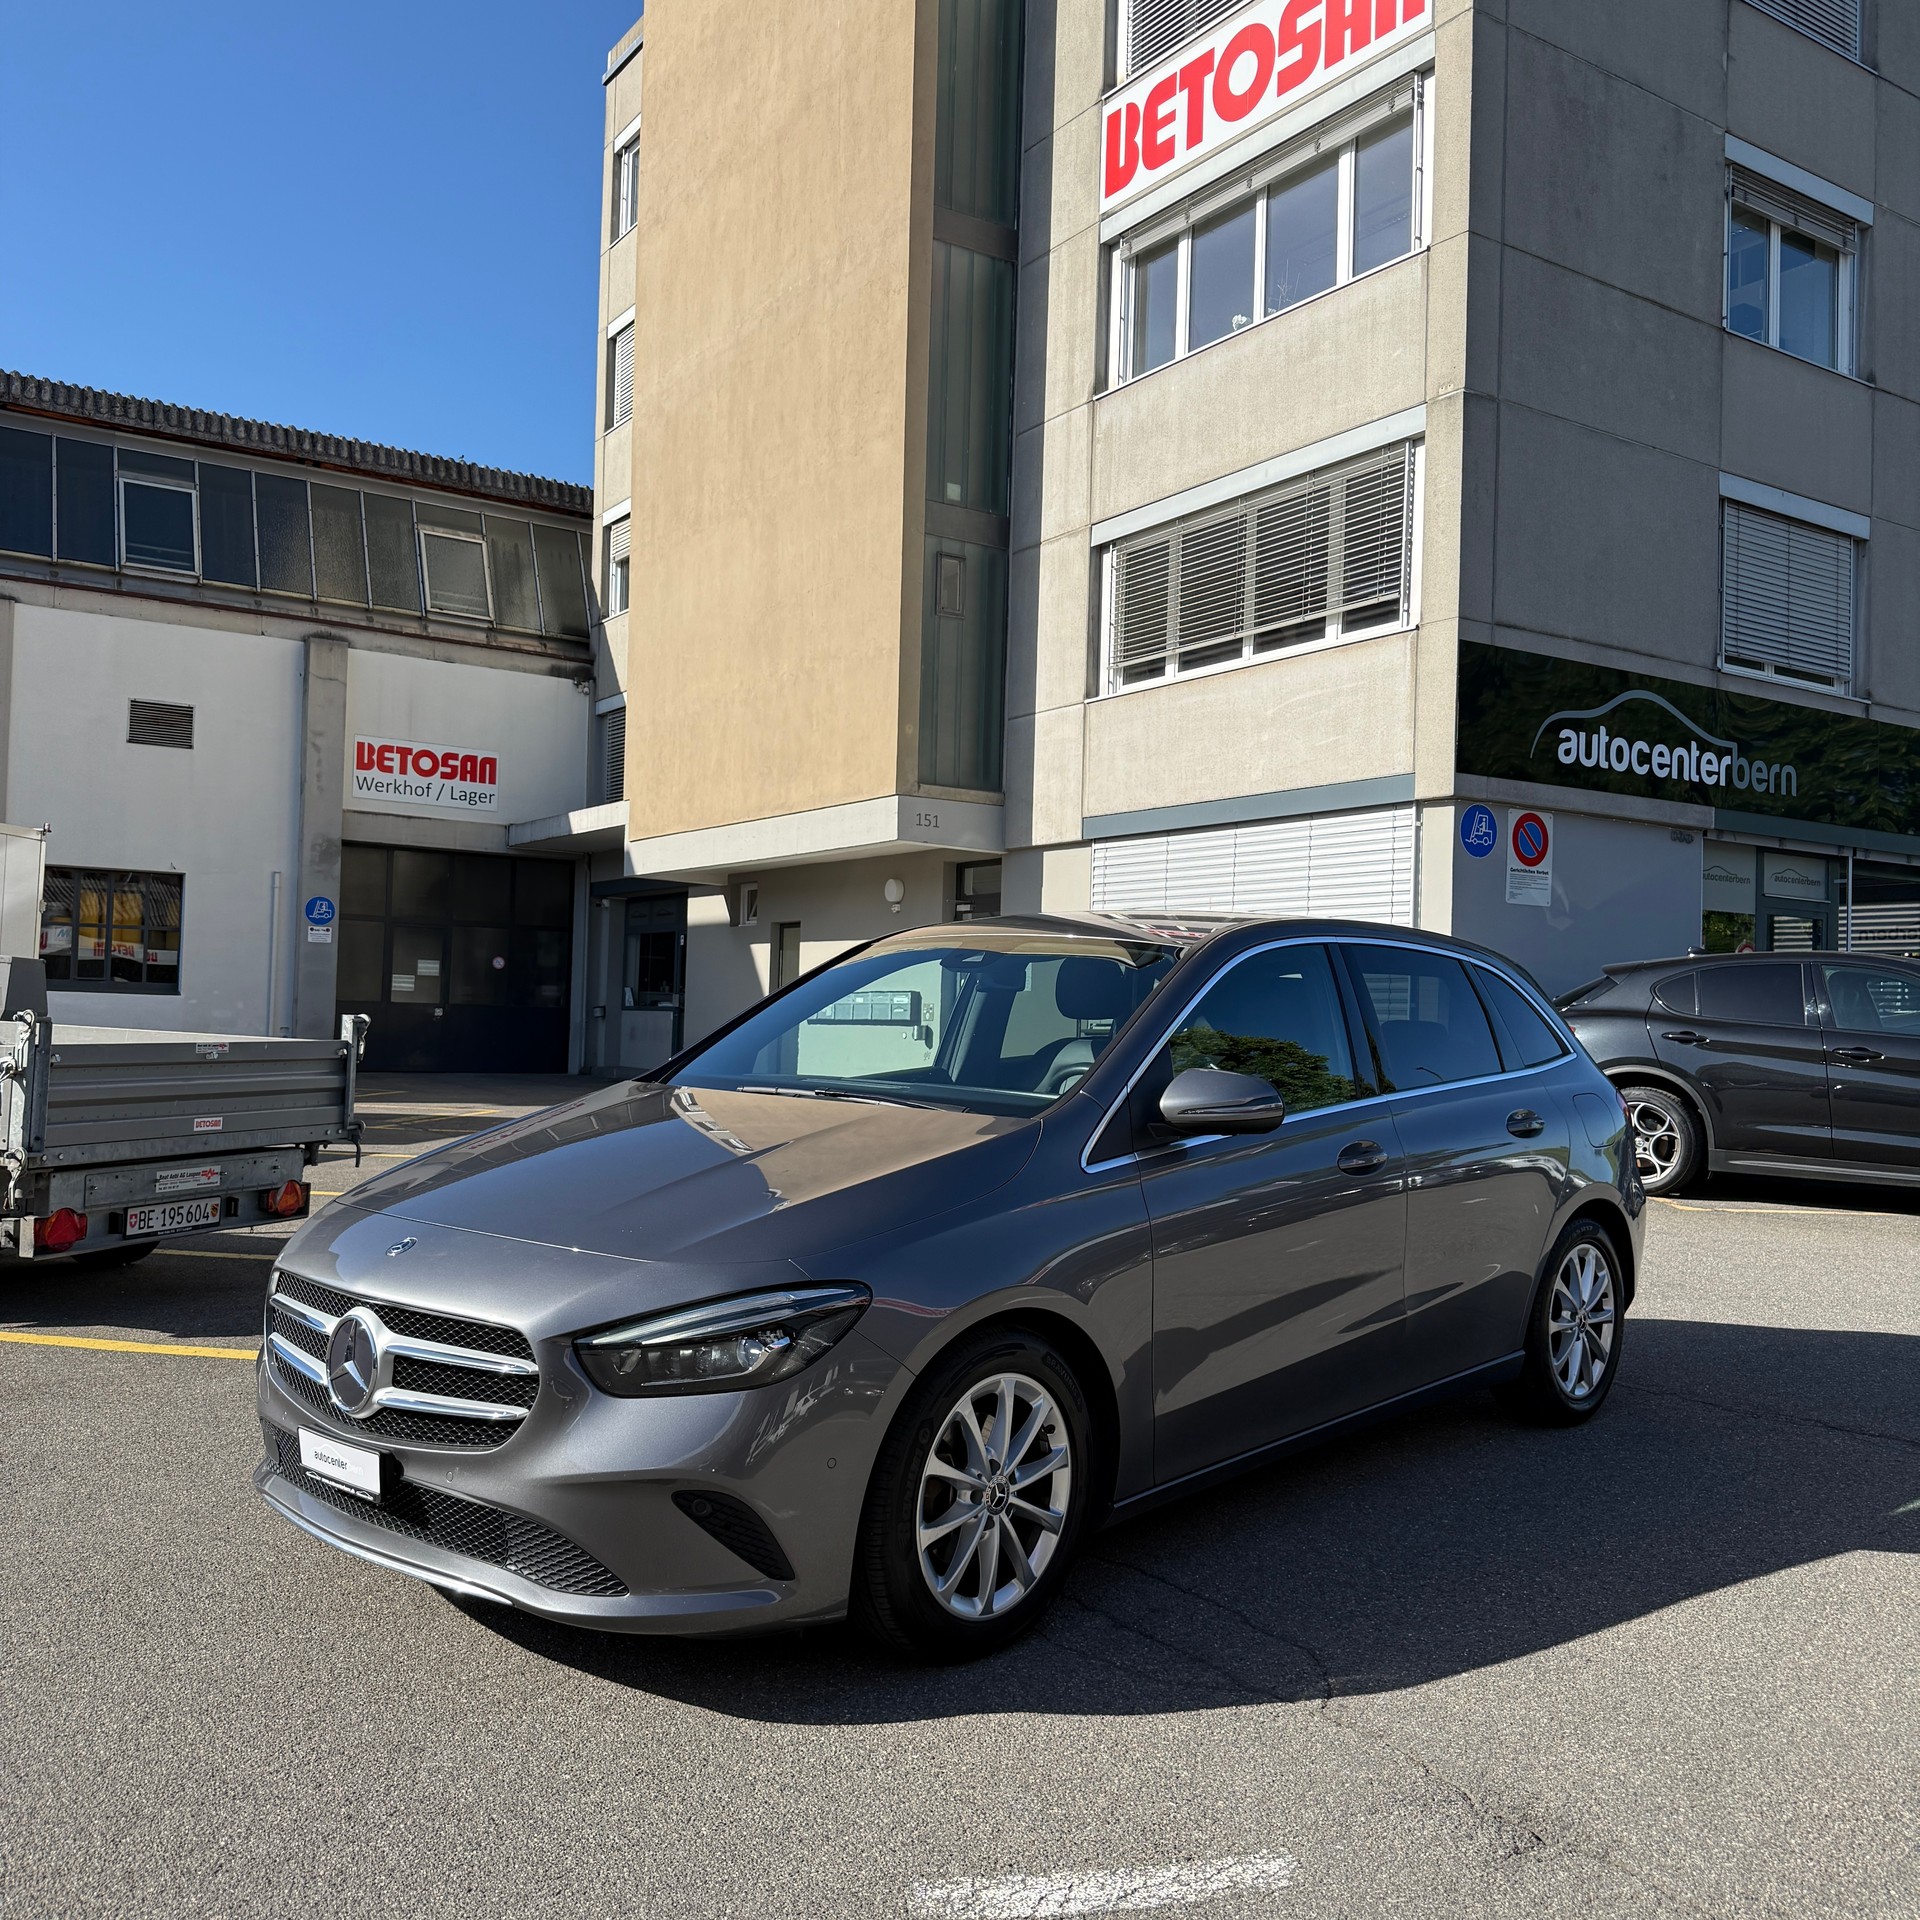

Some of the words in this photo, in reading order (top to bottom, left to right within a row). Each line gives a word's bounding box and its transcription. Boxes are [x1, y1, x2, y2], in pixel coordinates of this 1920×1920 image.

[356, 741, 498, 785] BETOSAN
[1557, 725, 1797, 797] autocenterbern
[356, 775, 433, 797] Werkhof
[450, 786, 496, 806] Lager
[916, 813, 940, 828] 151
[1774, 874, 1821, 887] autocenterbern
